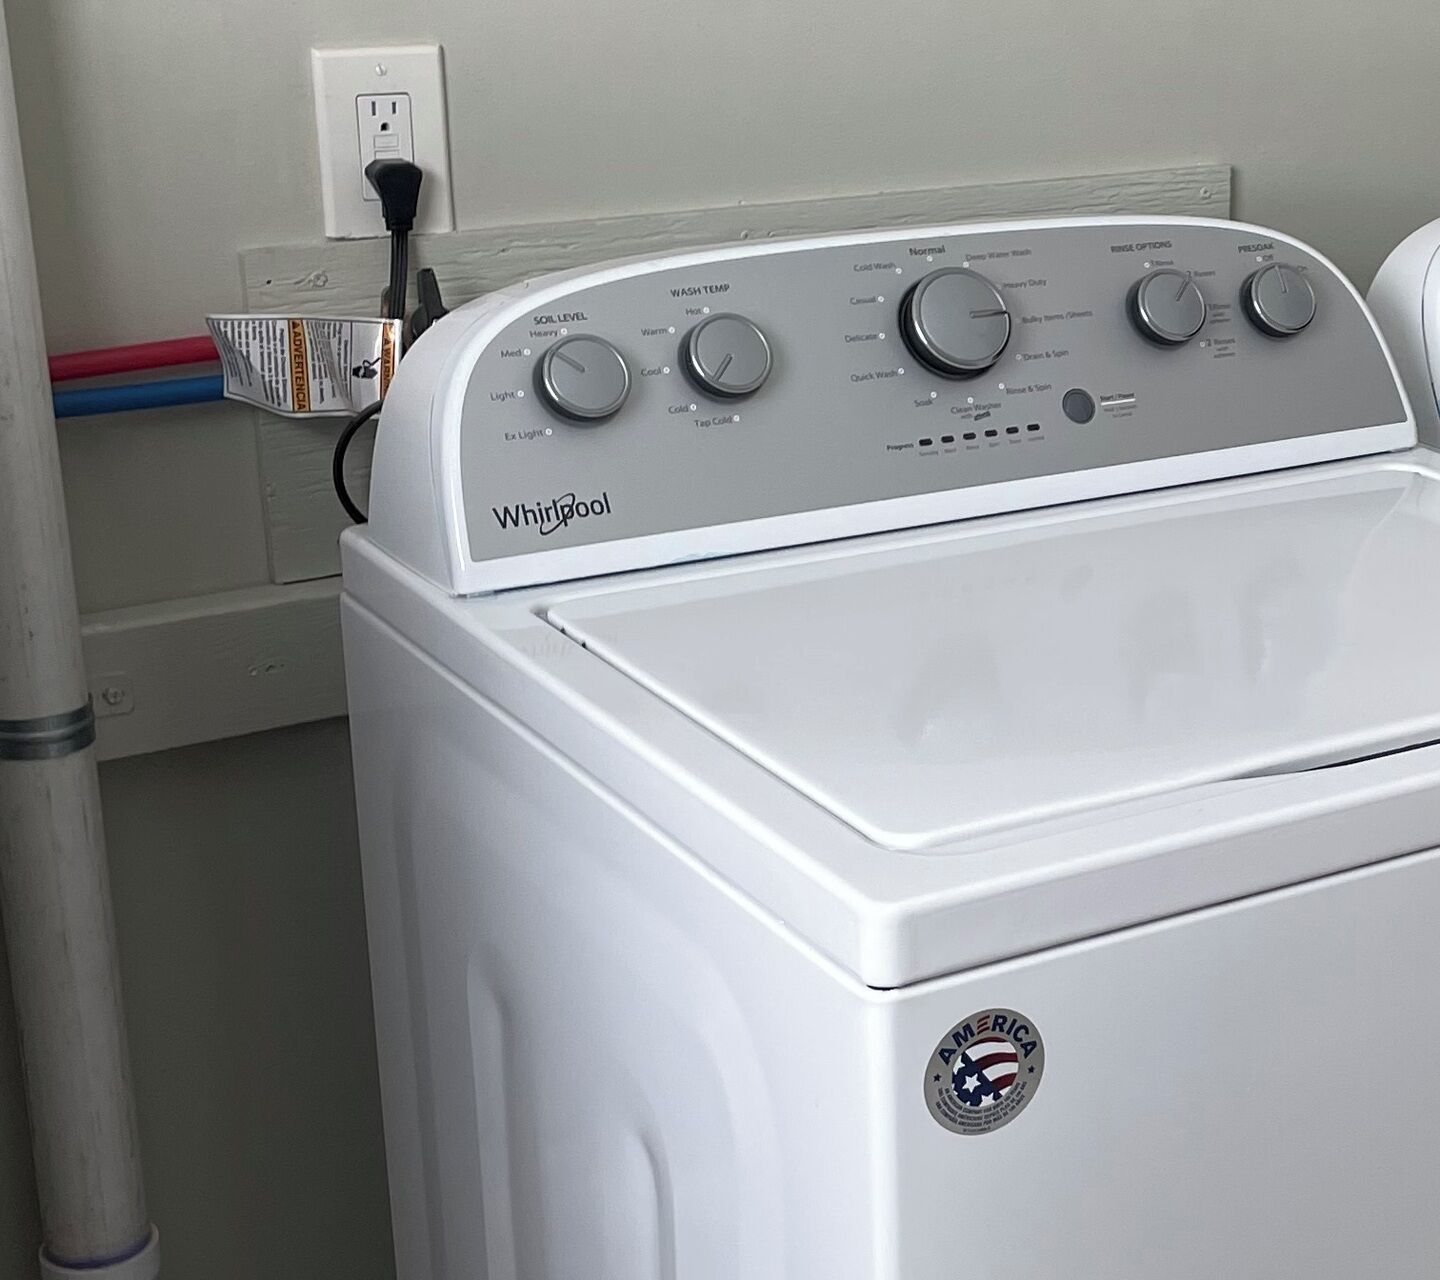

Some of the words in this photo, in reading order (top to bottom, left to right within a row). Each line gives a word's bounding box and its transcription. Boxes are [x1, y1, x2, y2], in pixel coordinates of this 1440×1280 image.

[909, 245, 946, 256] Normal
[1110, 244, 1134, 253] RINSE
[1135, 241, 1172, 251] OPTIONS
[1238, 243, 1274, 253] PRESOAK
[965, 253, 986, 261] Deep
[853, 263, 874, 272] Cold
[874, 262, 896, 270] Wash
[1028, 278, 1047, 287] Duty
[670, 288, 701, 297] WASH
[702, 284, 730, 294] TEMP
[850, 296, 877, 305] Casual
[685, 308, 701, 316] Hot
[533, 315, 556, 325] SOIL
[558, 312, 587, 322] LEVEL
[529, 329, 558, 338] Heavy
[640, 328, 667, 336] Warm
[845, 333, 877, 343] Delicate
[500, 348, 521, 358] Med
[1023, 352, 1044, 361] Drain
[1052, 350, 1069, 358] Spin
[293, 330, 306, 410] ADVERTENCIA
[640, 367, 662, 377] Cool
[850, 372, 875, 382] Quick
[876, 370, 899, 379] Wash
[1006, 387, 1027, 395] Rinse
[1035, 384, 1052, 392] Spin
[490, 391, 515, 401] Light
[914, 398, 933, 407] Soak
[668, 405, 689, 414] Cold
[950, 405, 972, 414] Clean
[973, 402, 1002, 412] Washer
[694, 419, 711, 428] Tap
[712, 415, 733, 426] Cold
[505, 433, 517, 441] Ex
[518, 429, 544, 440] Light
[886, 442, 914, 451] Progress
[492, 492, 611, 536] Whirlpool
[938, 1014, 1037, 1065] AMERICA
